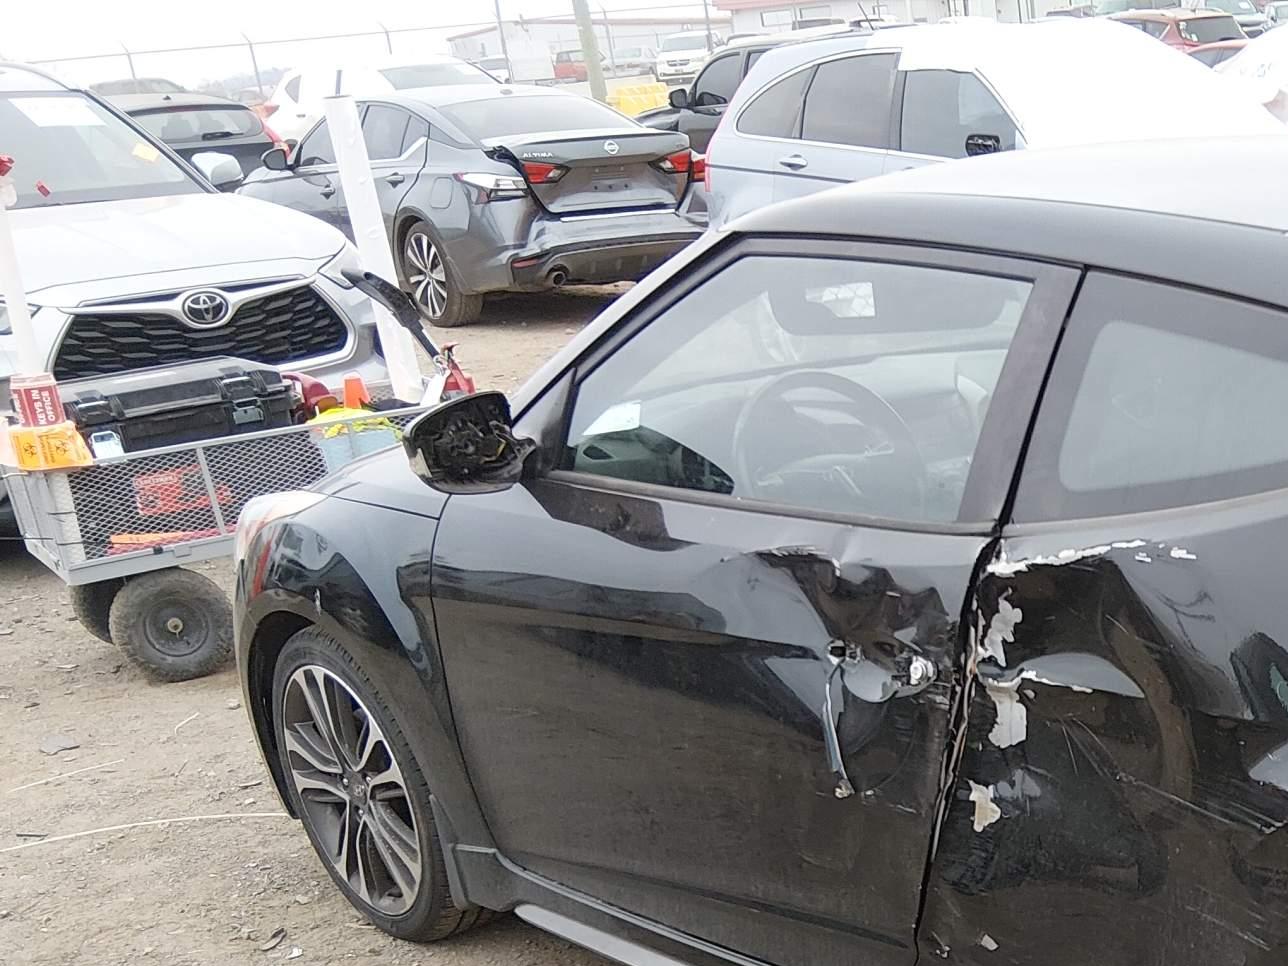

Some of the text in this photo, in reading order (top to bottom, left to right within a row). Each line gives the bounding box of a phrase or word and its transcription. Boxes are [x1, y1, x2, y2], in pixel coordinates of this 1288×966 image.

[30, 389, 41, 400] IN
[41, 390, 56, 422] OFFICE
[33, 401, 48, 425] KEYS
